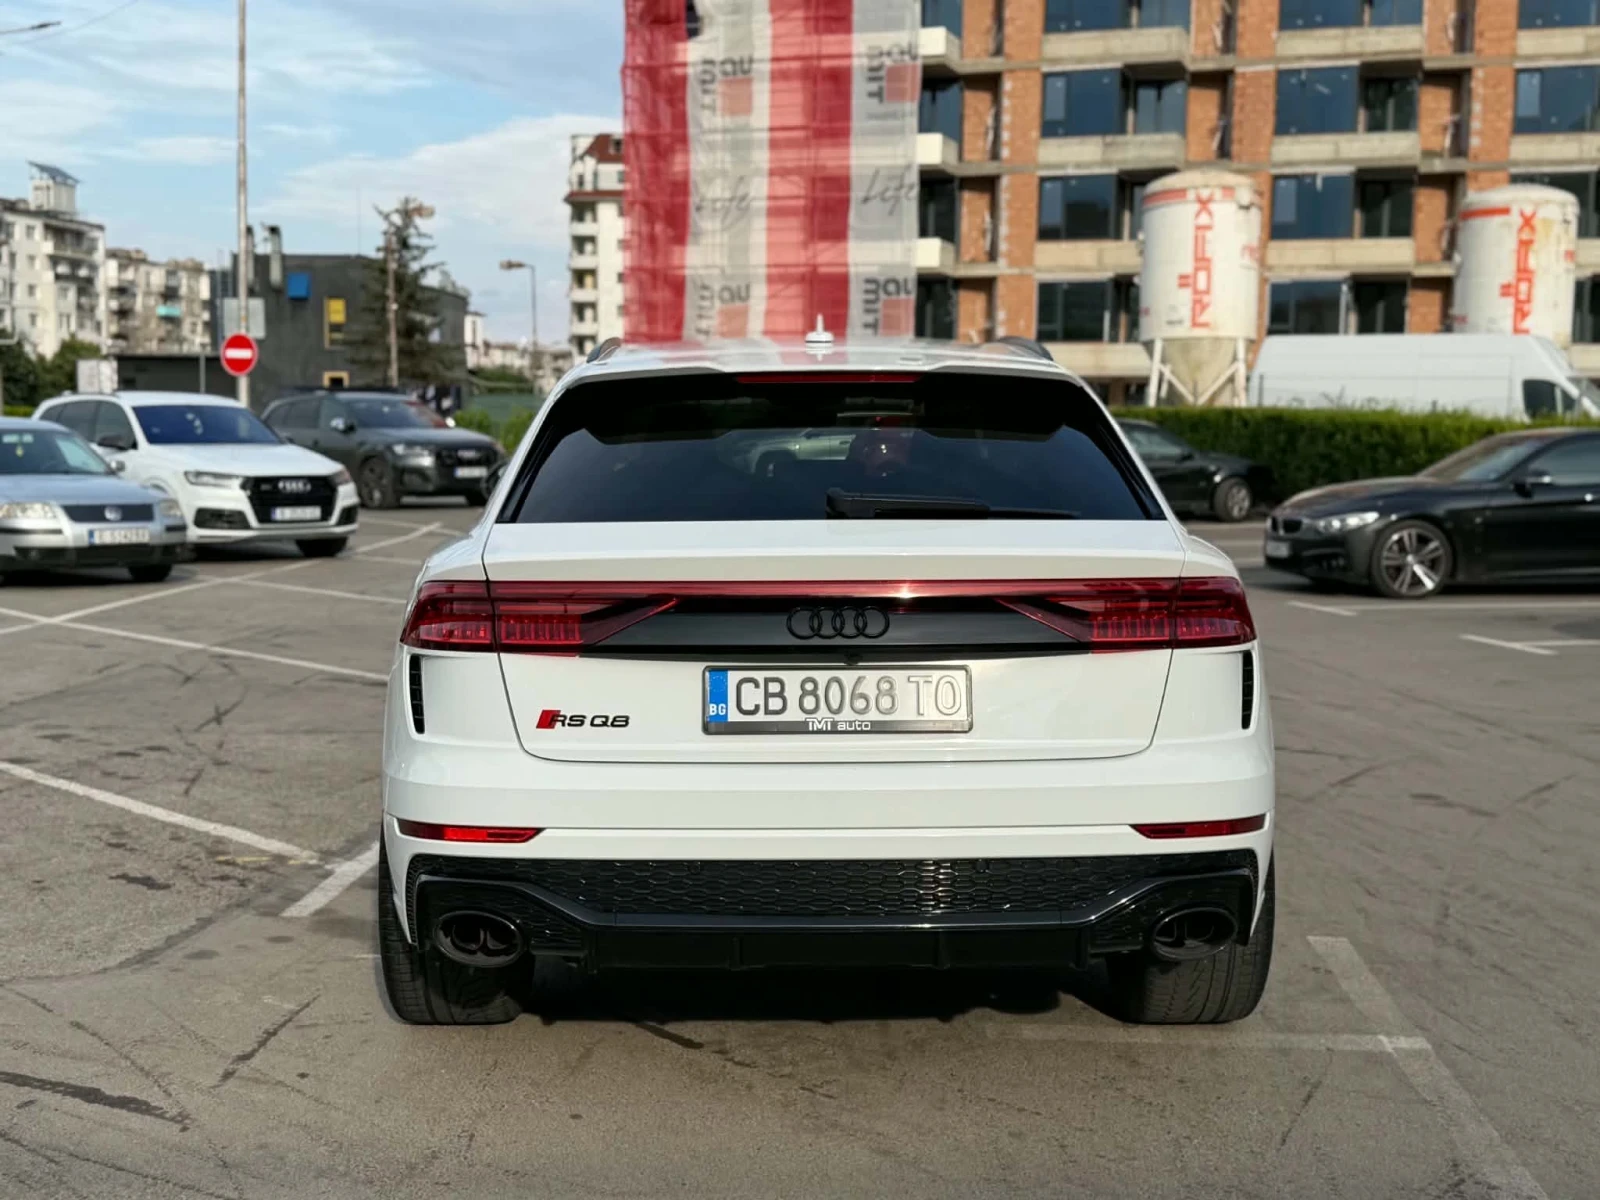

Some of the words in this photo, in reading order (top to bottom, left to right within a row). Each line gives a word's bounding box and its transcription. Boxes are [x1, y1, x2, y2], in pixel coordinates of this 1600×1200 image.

[735, 676, 789, 716] CB
[798, 675, 900, 716] 8068
[709, 703, 727, 717] BG
[547, 714, 588, 728] RS
[589, 714, 631, 729] Q8
[805, 717, 835, 732] TMT
[836, 718, 872, 731] auto
